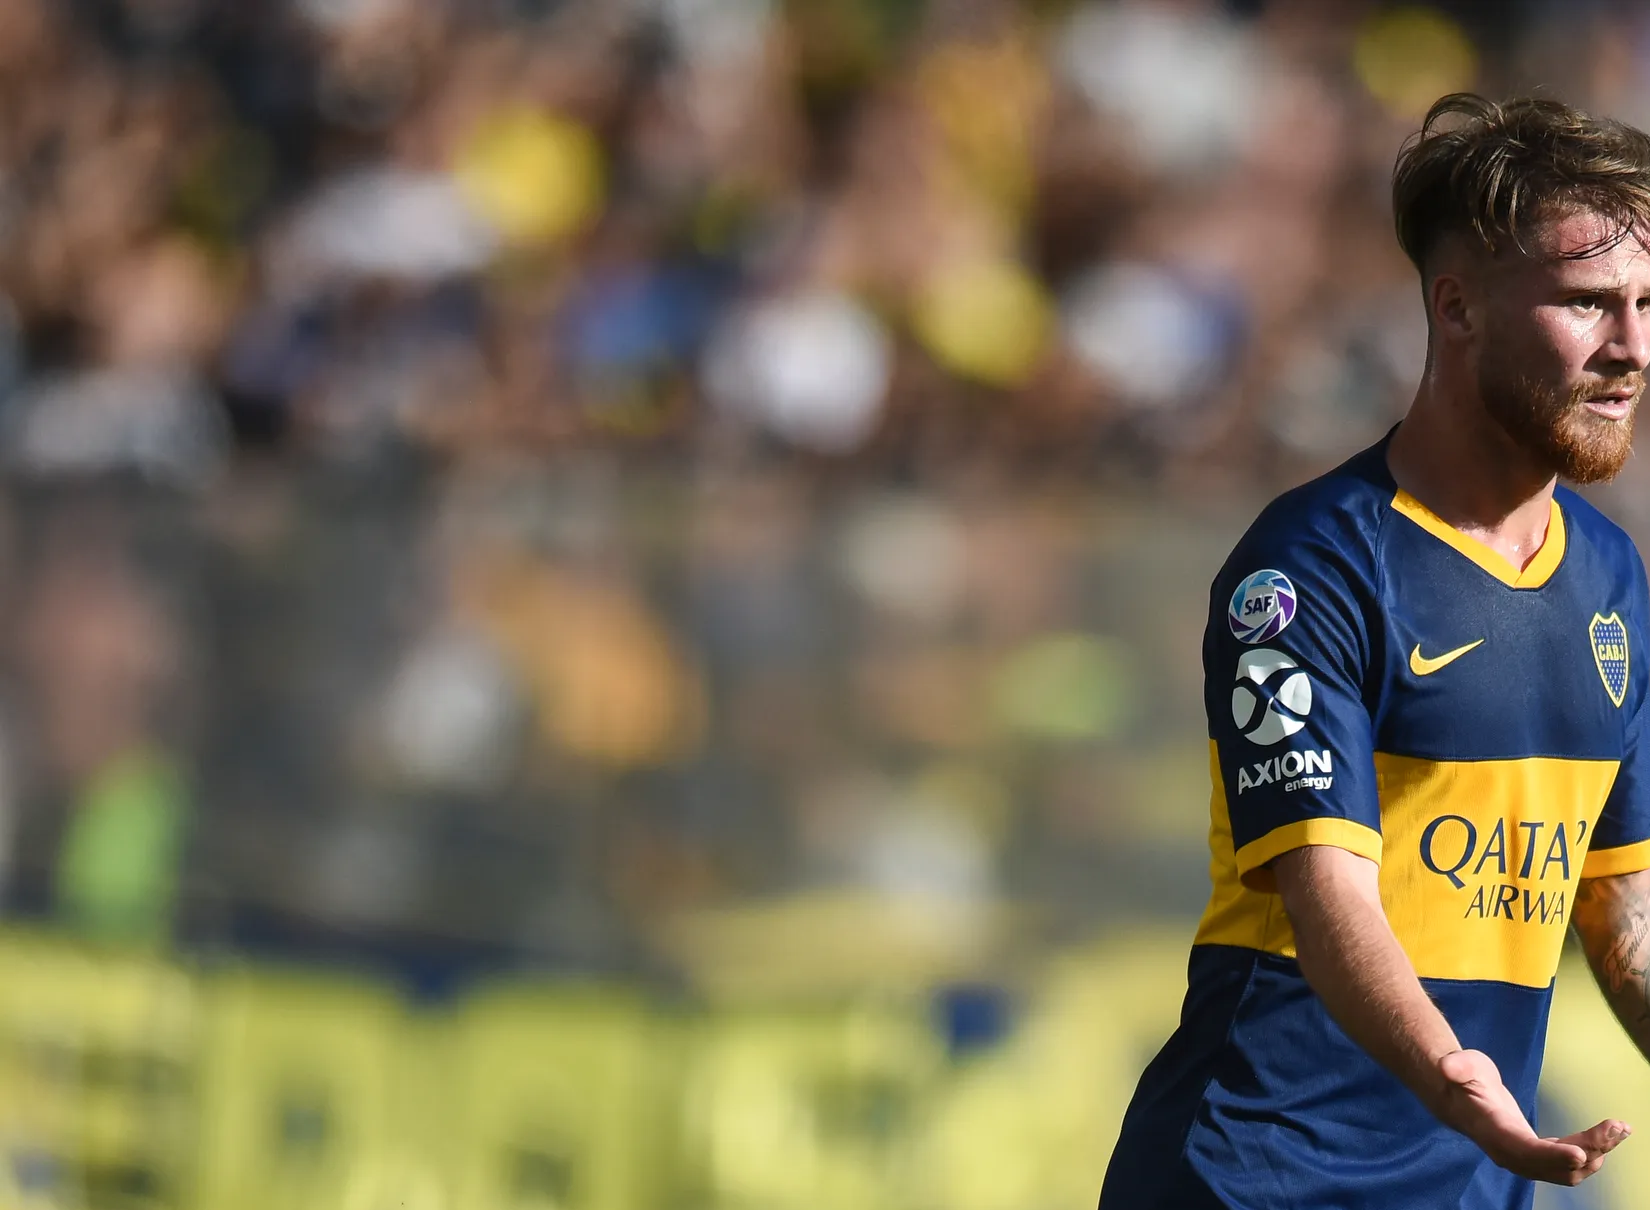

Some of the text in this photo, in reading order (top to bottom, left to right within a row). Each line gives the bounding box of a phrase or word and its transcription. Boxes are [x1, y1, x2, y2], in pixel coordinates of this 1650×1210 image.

[1244, 594, 1275, 616] SAF
[1597, 644, 1625, 661] CABJ
[1238, 750, 1333, 795] AXION
[1285, 776, 1333, 792] energy
